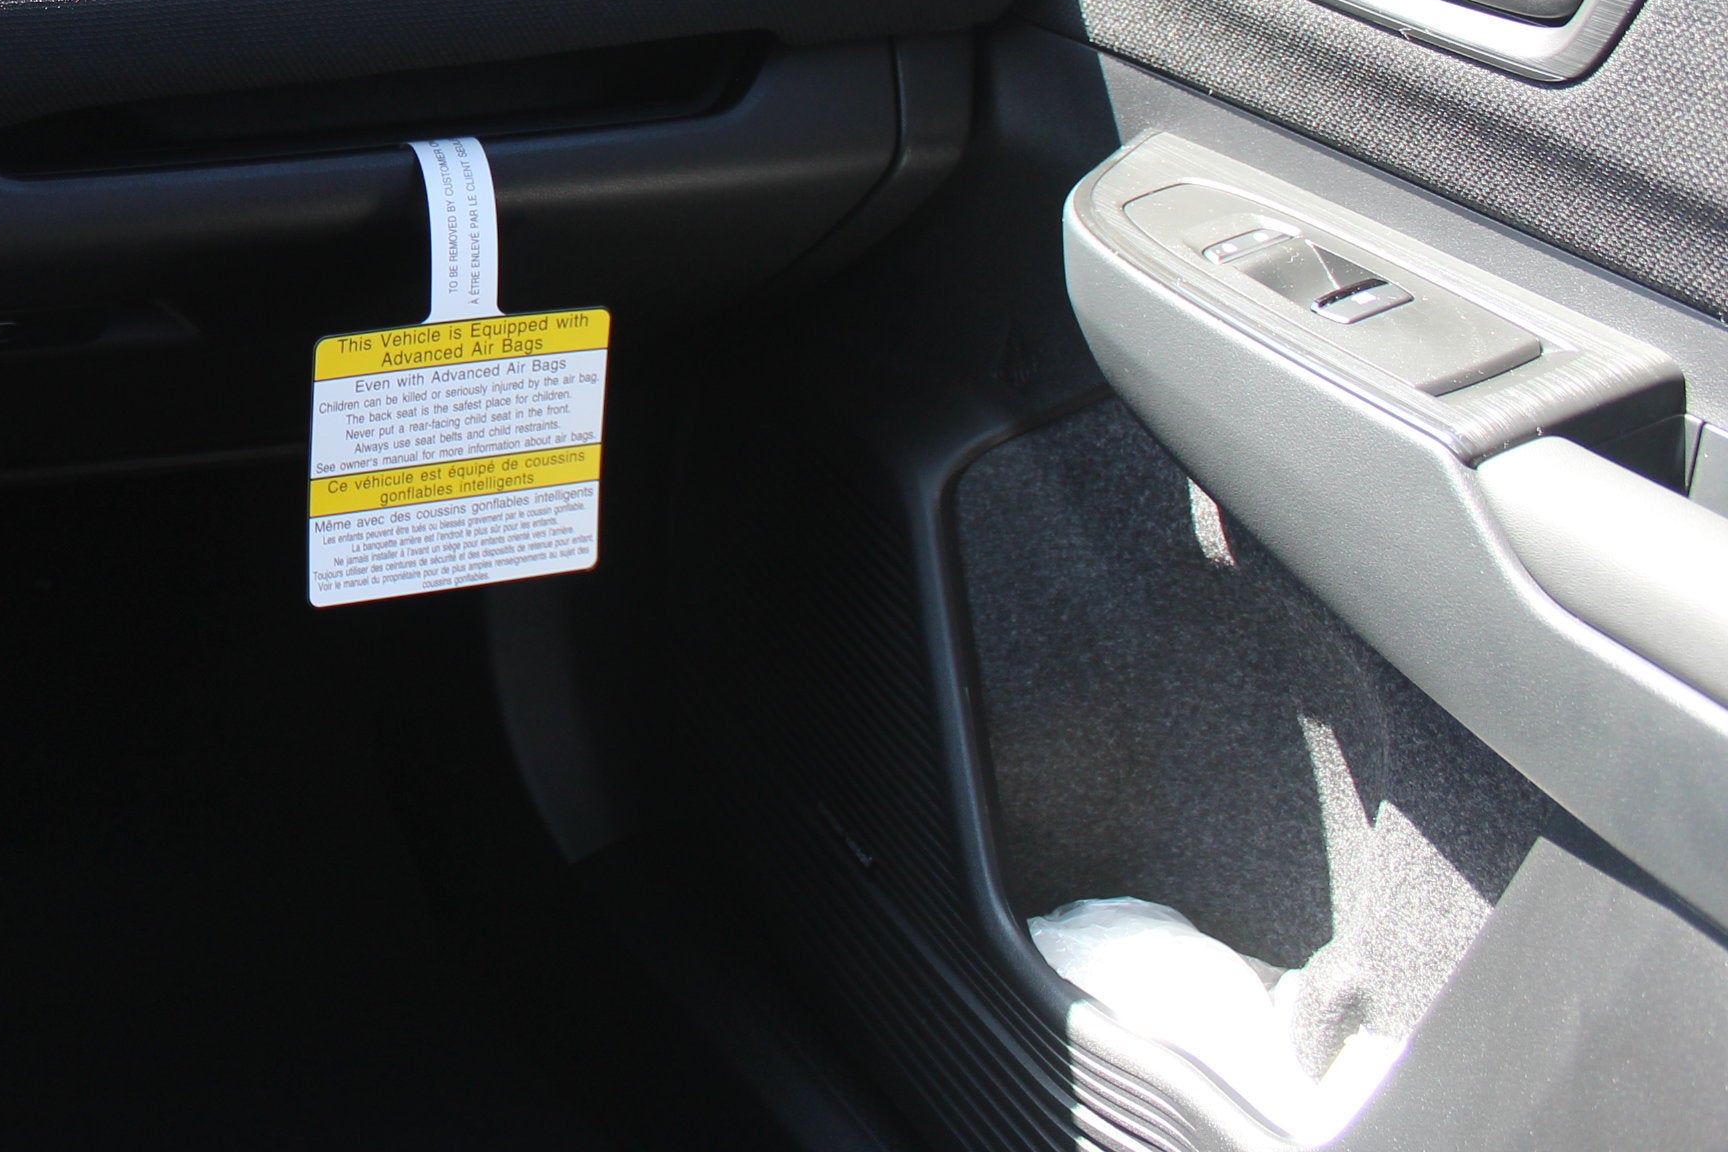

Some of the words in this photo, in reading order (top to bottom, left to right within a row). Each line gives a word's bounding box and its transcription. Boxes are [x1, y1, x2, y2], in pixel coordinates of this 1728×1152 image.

[434, 148, 454, 197] CUSTOMER
[460, 160, 475, 191] CLIENT
[447, 200, 456, 213] BY
[468, 195, 477, 206] LE
[469, 209, 479, 229] PAR
[449, 218, 458, 262] REMOVED
[449, 266, 458, 277] BE
[449, 280, 458, 294] TO
[338, 338, 372, 354] This
[381, 329, 440, 348] Vehicle
[449, 325, 463, 341] is
[470, 317, 548, 339] Equipped
[557, 313, 589, 329] with
[381, 344, 463, 367] Advanced
[472, 342, 494, 356] Air
[502, 338, 543, 354] Bags
[356, 380, 390, 393] Even
[398, 374, 424, 387] with
[431, 364, 500, 384] Advanced
[507, 362, 525, 374] Air
[532, 359, 566, 373] Bags
[319, 401, 359, 414] Children
[364, 398, 381, 408] can
[386, 395, 398, 405] be
[403, 391, 427, 402] killed
[431, 390, 441, 400] or
[445, 381, 488, 398] seriously
[492, 378, 524, 393] injured
[528, 378, 540, 389] by
[544, 376, 559, 386] the
[563, 374, 575, 384] air
[346, 414, 364, 425] The
[369, 411, 392, 423] back
[397, 407, 417, 419] seat
[422, 406, 429, 416] is
[434, 403, 448, 414] the
[452, 398, 482, 413] safest
[485, 396, 511, 409] place
[516, 394, 528, 404] for
[346, 429, 374, 440] Never
[379, 425, 394, 437] put
[398, 424, 404, 433] a
[409, 418, 460, 431] rear-facing
[465, 414, 486, 425] child
[491, 411, 511, 422] seat
[516, 409, 523, 419] in
[528, 407, 543, 417] the
[316, 463, 335, 474] See
[340, 457, 378, 471] owner's
[382, 452, 418, 465] manual
[422, 449, 435, 460] for
[439, 447, 463, 459] more
[468, 440, 520, 454] information
[525, 435, 551, 447] about
[555, 432, 567, 444] air
[355, 443, 389, 454] Always
[394, 439, 410, 448] use
[415, 435, 436, 446] seat
[440, 430, 463, 444] belts
[467, 428, 485, 440] and
[489, 425, 511, 437] child
[328, 480, 348, 494] Ce
[355, 472, 413, 490] véhicule
[421, 468, 441, 481] est
[448, 460, 495, 479] équipé
[502, 459, 518, 471] de
[525, 451, 585, 468] coussins
[380, 484, 452, 506] gonflables
[460, 474, 534, 493] intelligents
[314, 520, 351, 533] Même
[357, 516, 384, 527] avec
[390, 512, 411, 524] des
[416, 504, 466, 519] coussins
[472, 496, 529, 514] gonflables
[535, 487, 593, 503] intelligents
[323, 535, 336, 545] Les
[338, 532, 363, 542] enfants
[366, 529, 394, 540] peuvent
